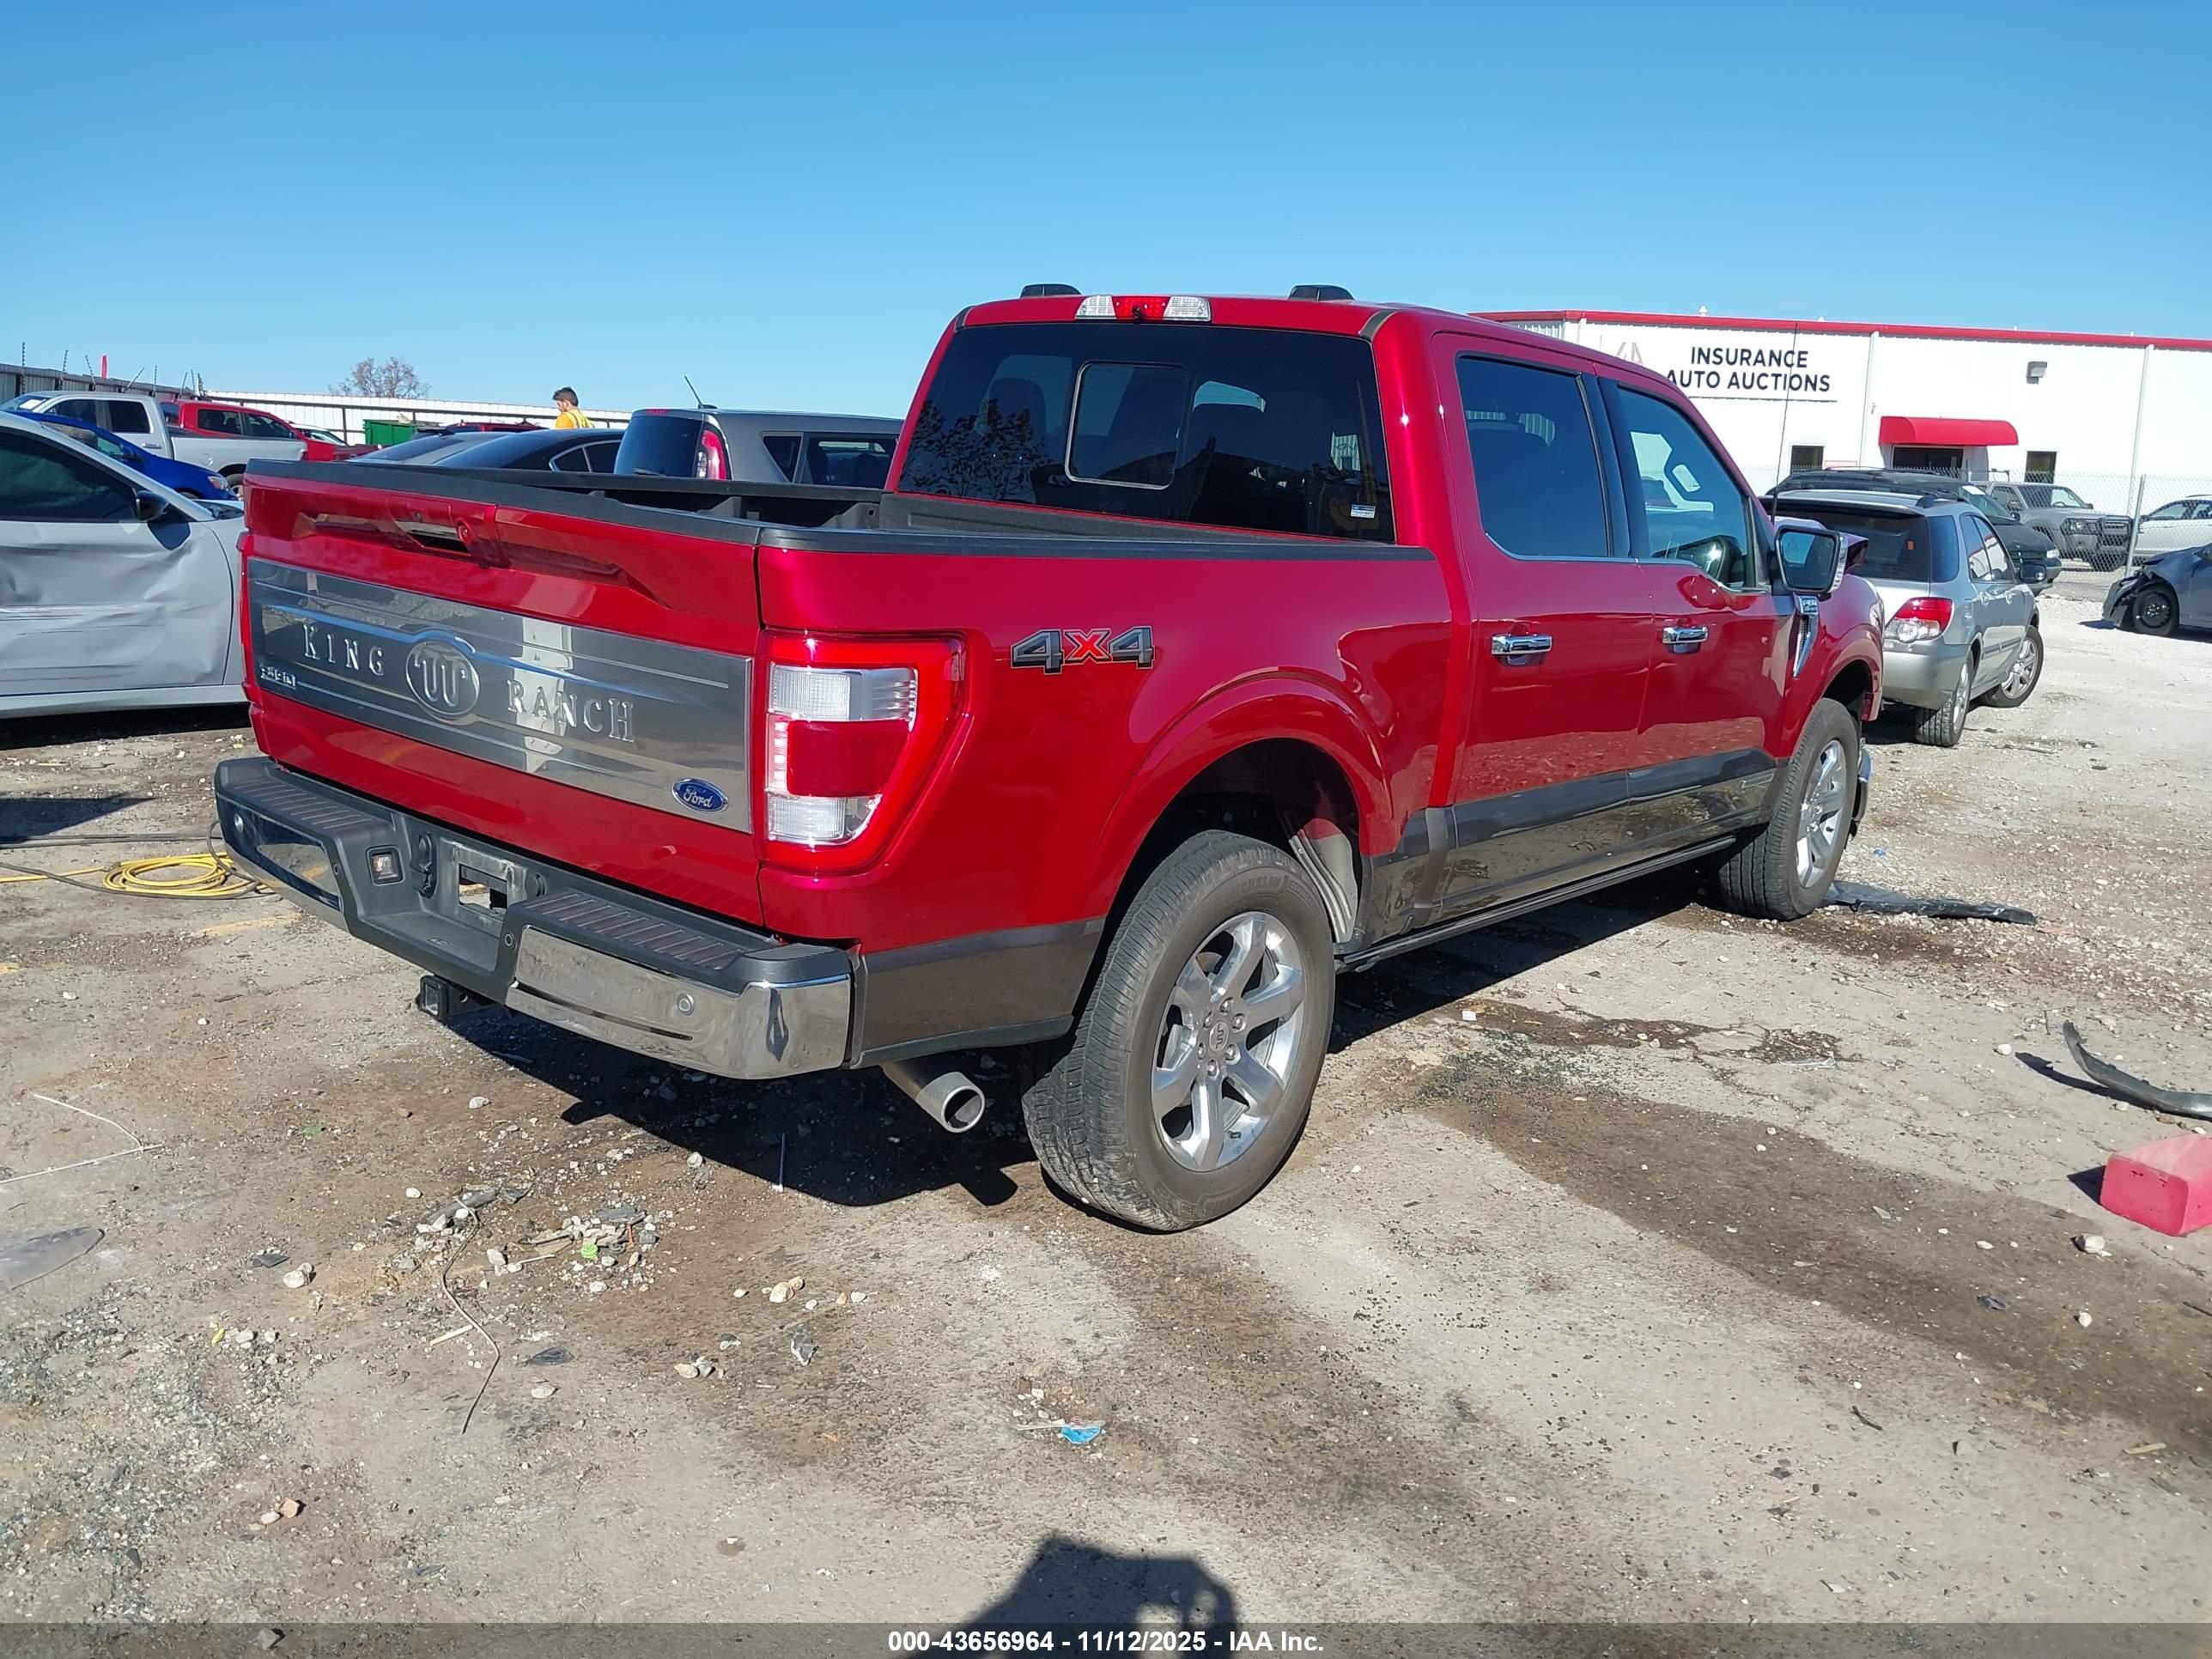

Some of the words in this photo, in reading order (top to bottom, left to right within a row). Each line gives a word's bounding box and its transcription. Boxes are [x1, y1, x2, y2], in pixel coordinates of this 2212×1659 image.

[1691, 346, 1808, 368] INSURANCE
[1667, 369, 1720, 389] AUTO
[1727, 371, 1831, 392] AUCTIONS
[302, 623, 386, 677] KING
[507, 678, 635, 744] RANCH
[683, 785, 714, 808] Ford
